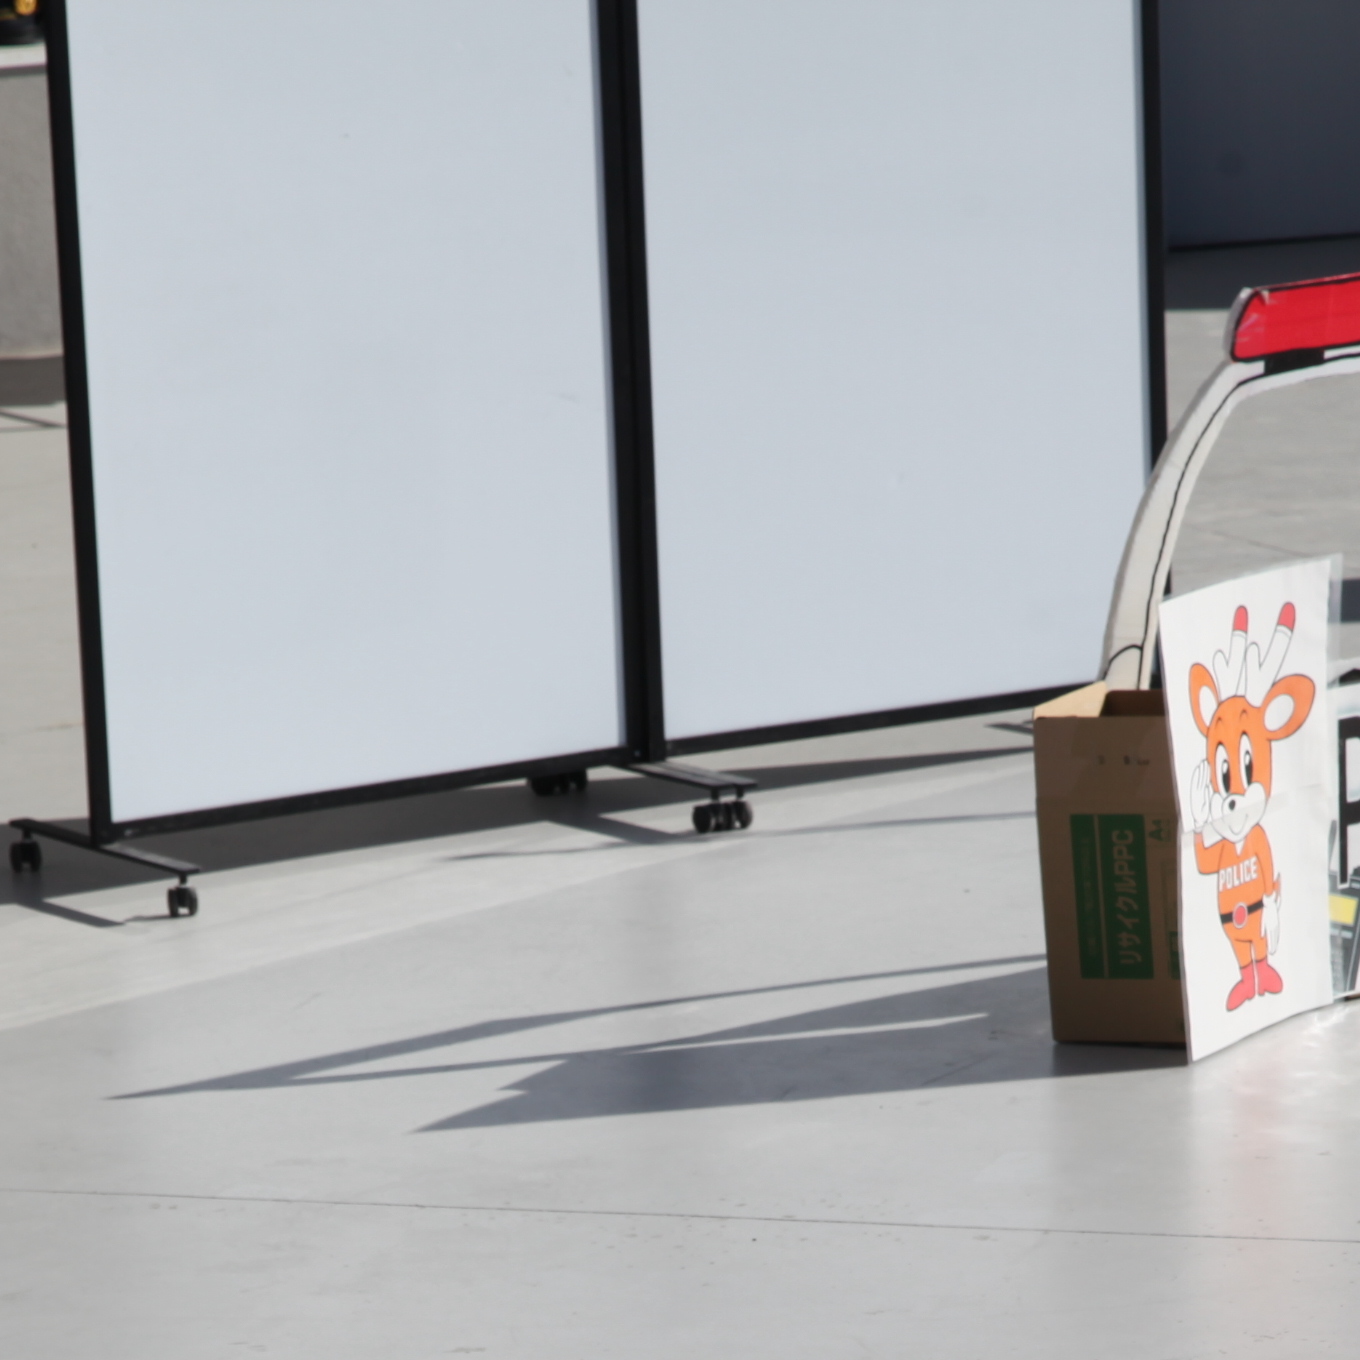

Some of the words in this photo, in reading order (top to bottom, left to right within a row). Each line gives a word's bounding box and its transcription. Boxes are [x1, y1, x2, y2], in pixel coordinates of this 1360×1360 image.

[1111, 828, 1143, 965] リサイクルPPC
[1218, 855, 1260, 893] POLICE
